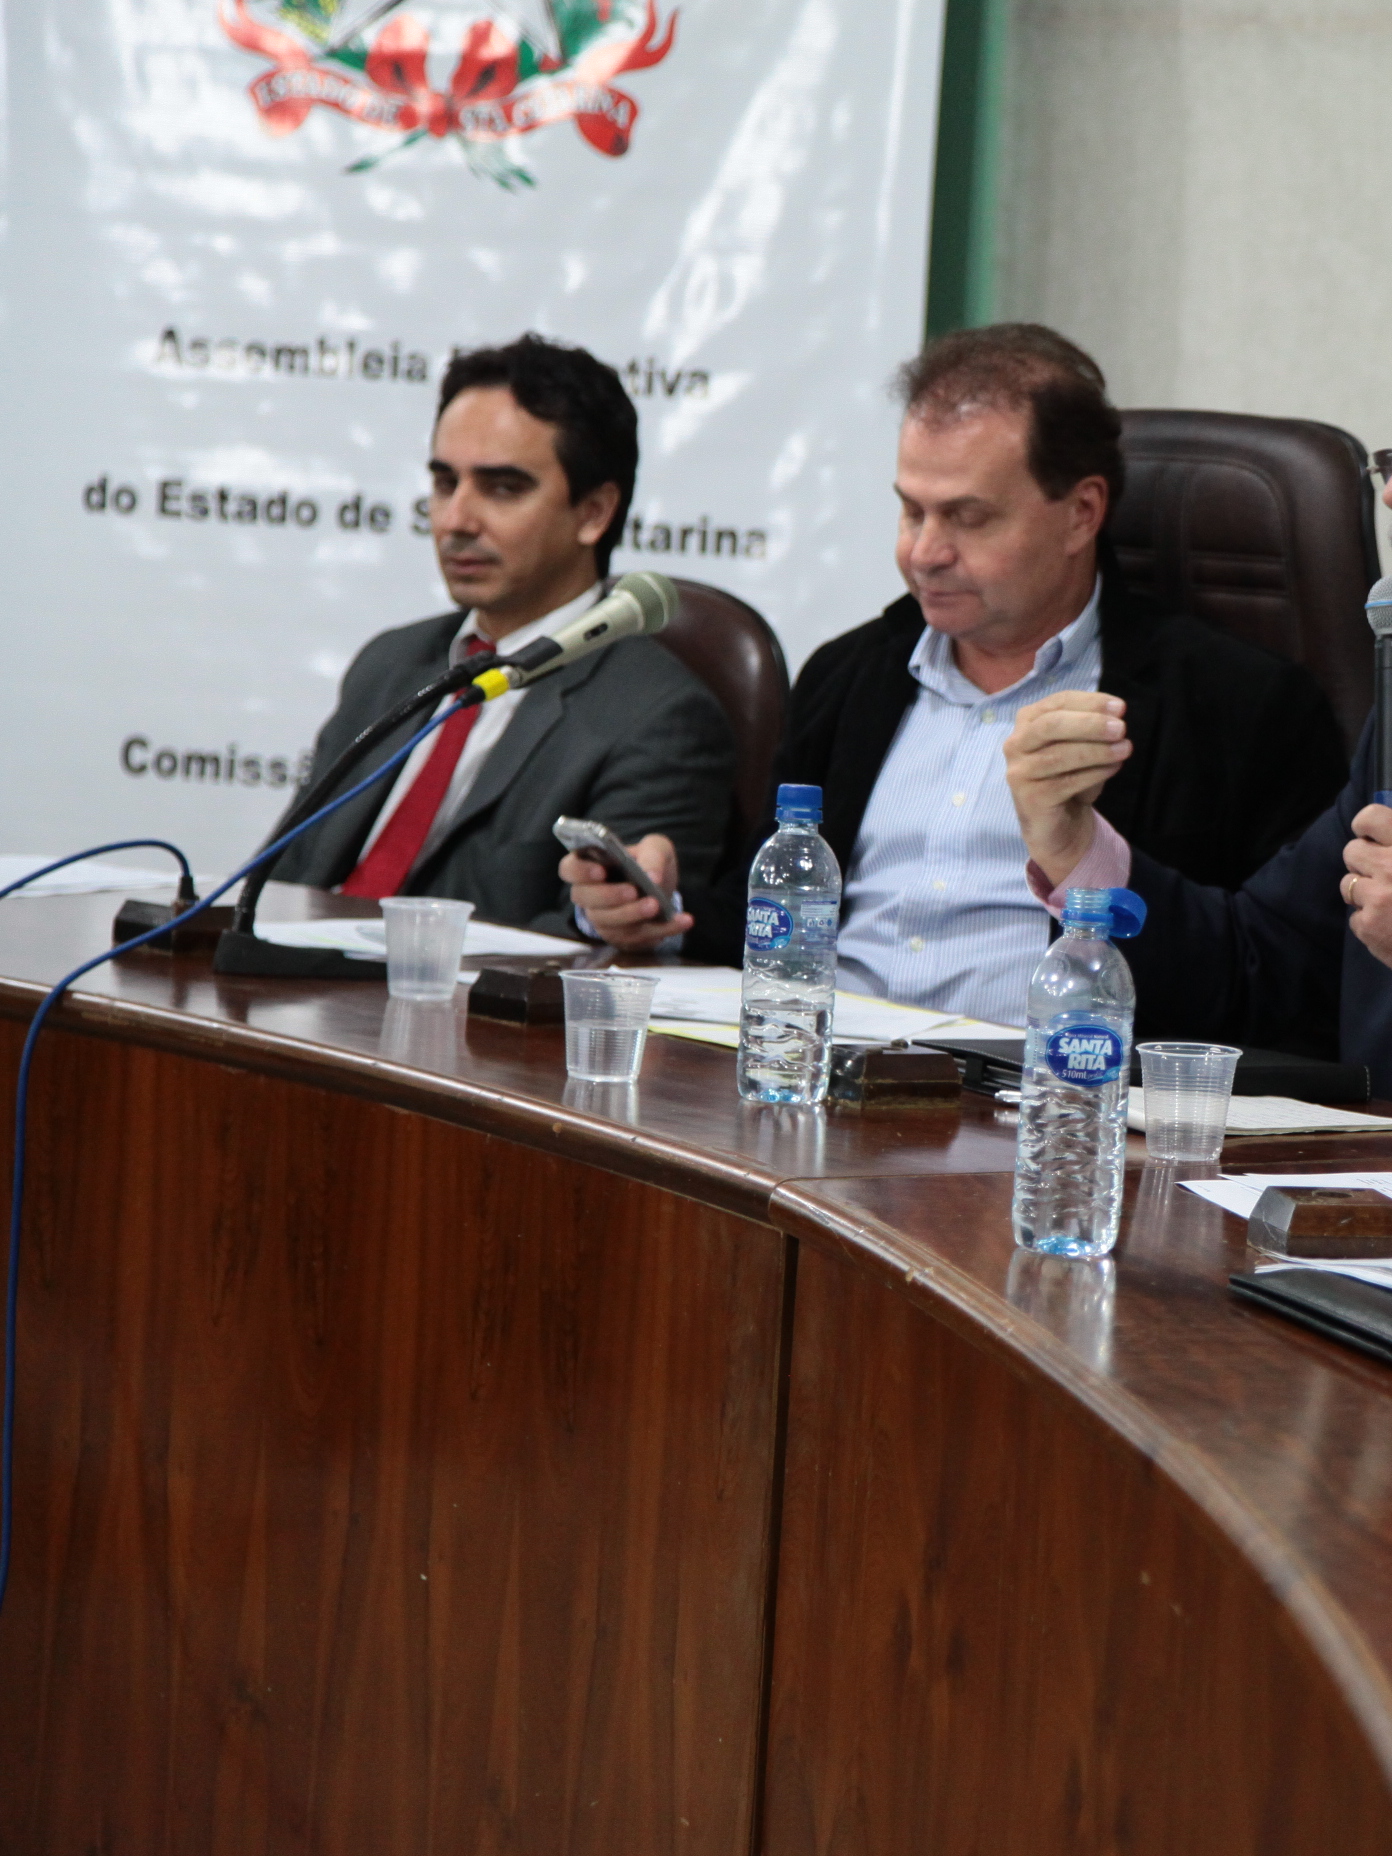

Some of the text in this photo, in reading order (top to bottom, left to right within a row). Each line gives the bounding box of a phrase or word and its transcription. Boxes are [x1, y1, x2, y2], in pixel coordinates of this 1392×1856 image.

[156, 327, 428, 382] Assembleia
[83, 476, 767, 559] do Estado de S tarina
[1058, 1037, 1113, 1056] SANTA
[1067, 1053, 1106, 1071] RITA
